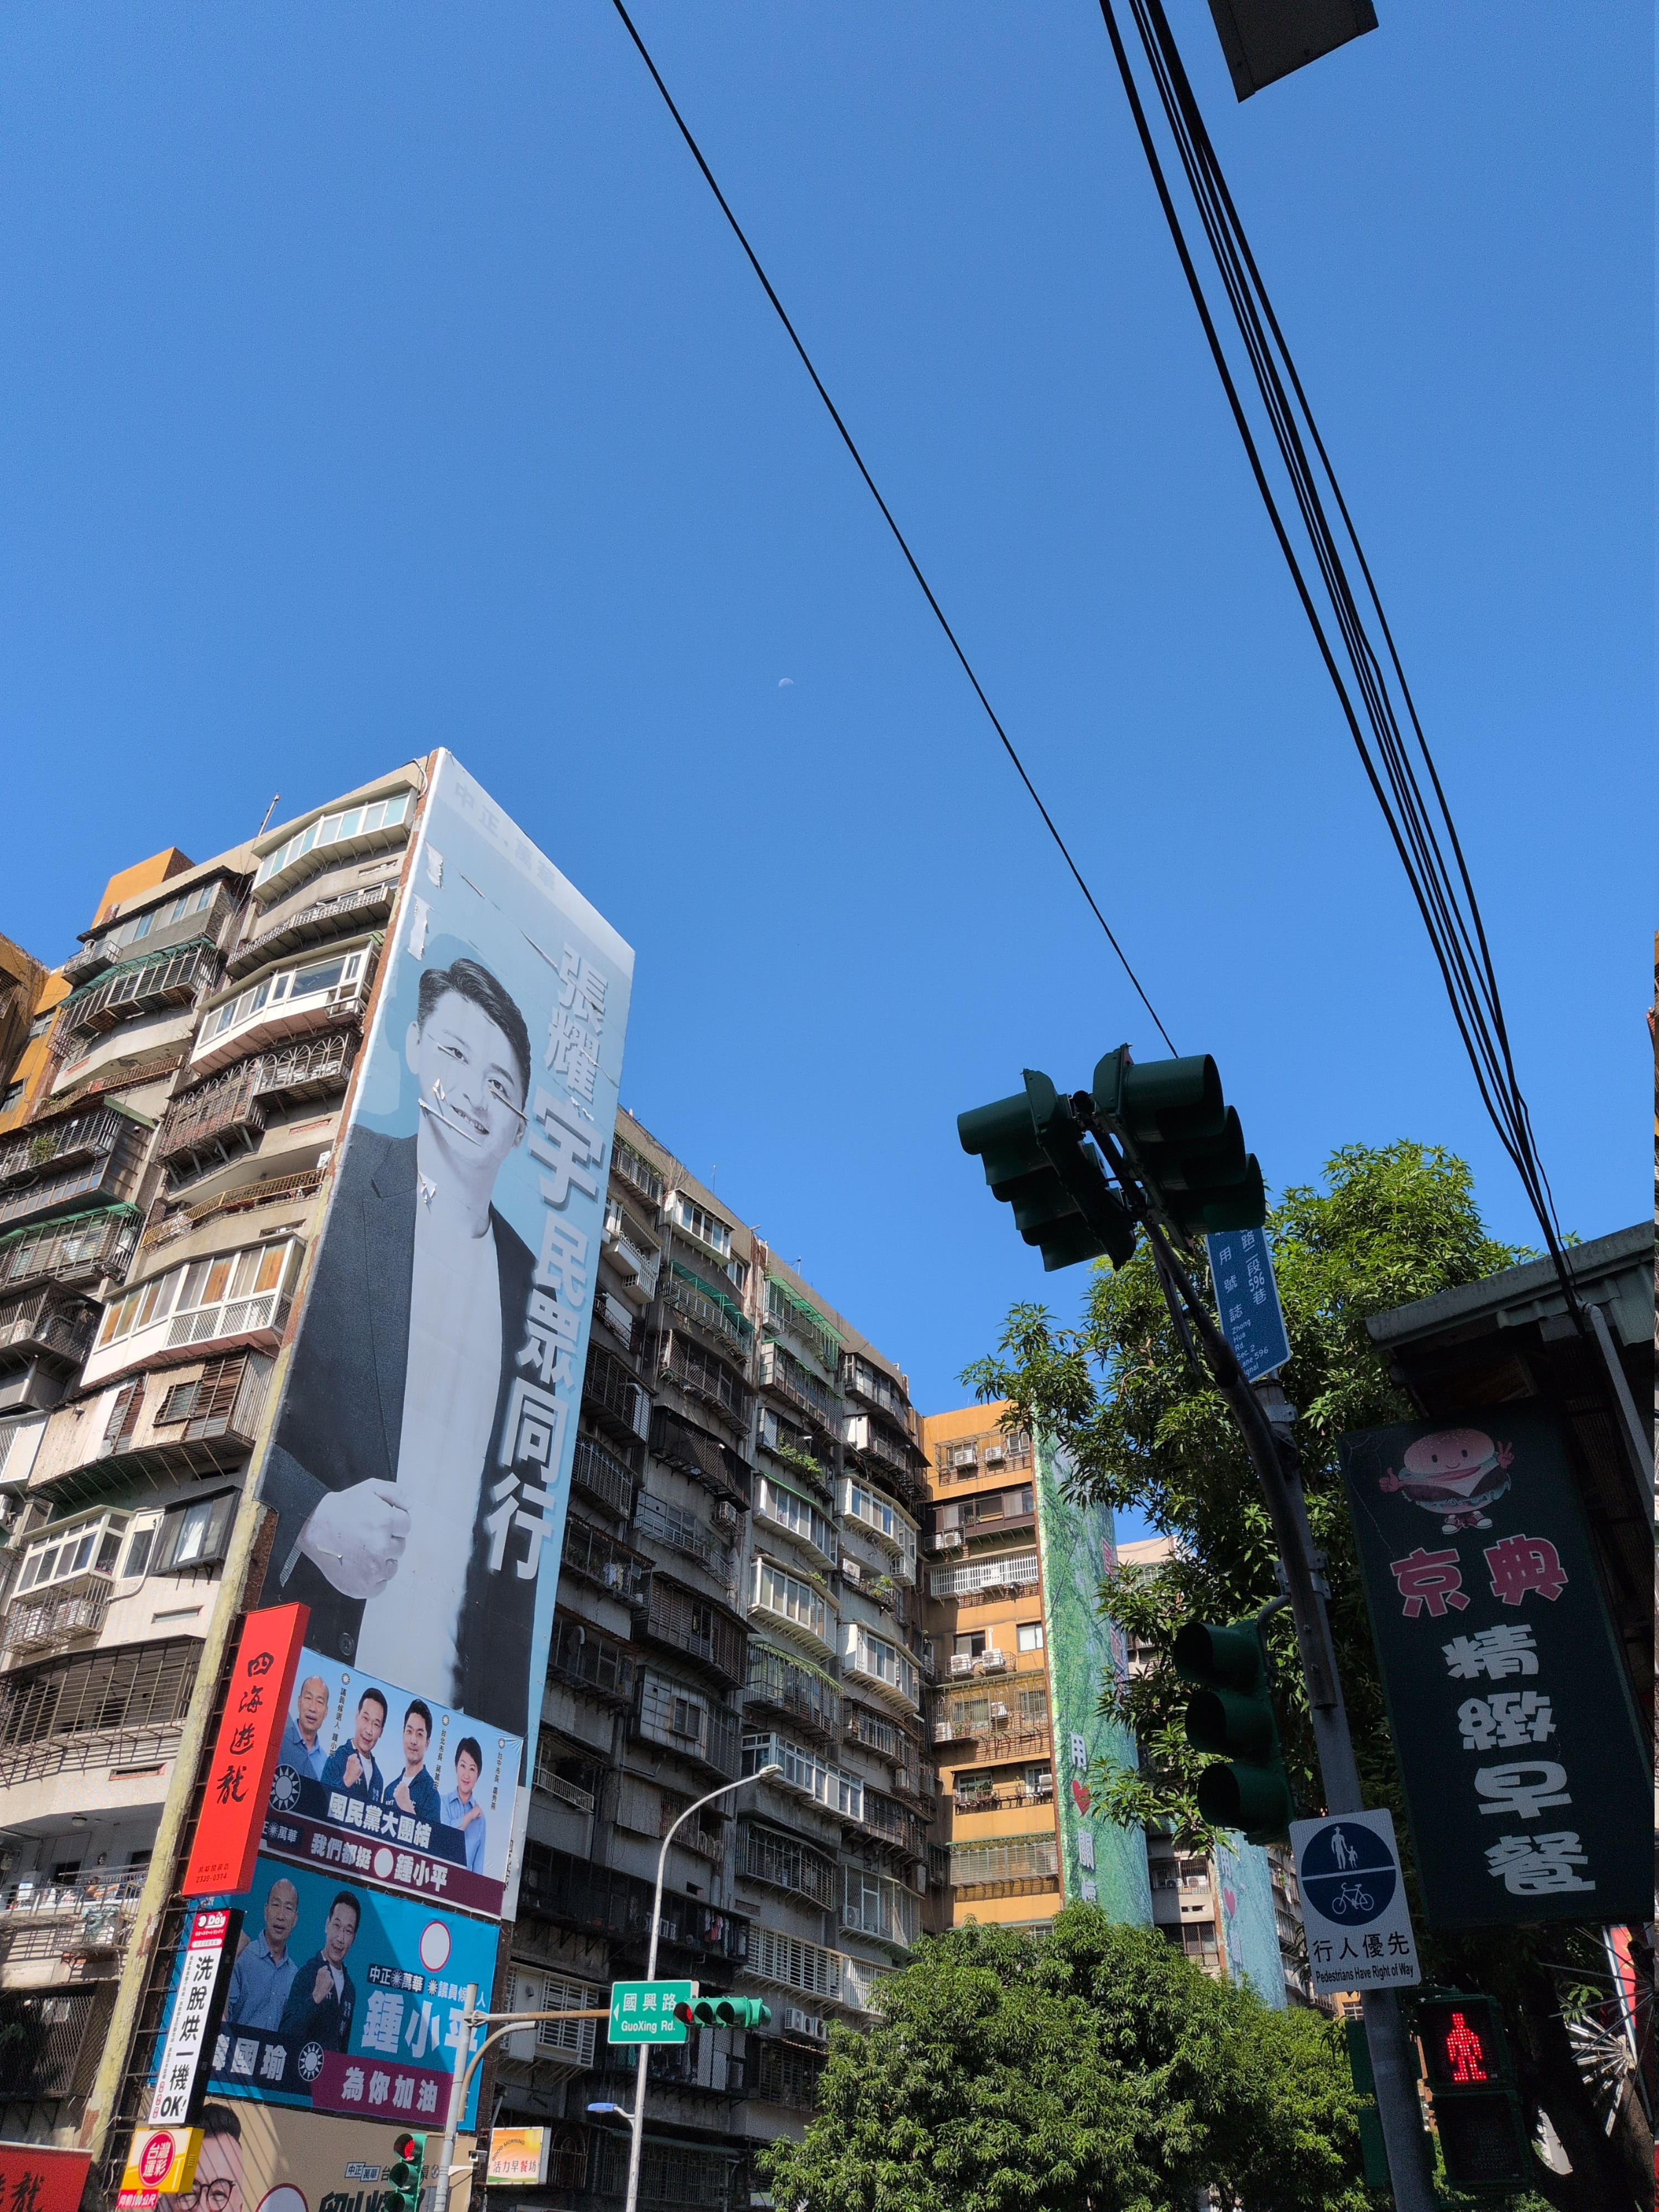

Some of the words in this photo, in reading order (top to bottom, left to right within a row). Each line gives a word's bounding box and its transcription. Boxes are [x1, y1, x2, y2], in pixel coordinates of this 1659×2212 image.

[1215, 1232, 1243, 1323] 用號誌
[1239, 1230, 1267, 1305] 路二段596巷
[1232, 1319, 1251, 1335] Zhong
[1233, 1332, 1246, 1344] Hua
[1241, 1358, 1254, 1369] ane
[1254, 1346, 1269, 1360] 596
[1250, 1344, 1256, 1353] 2
[1390, 1533, 1568, 1618] 京典
[216, 1652, 275, 1804] 四海遊龍
[1070, 1731, 1087, 1772] 用
[1441, 1624, 1596, 1896] 精緻早餐
[327, 1792, 432, 1849] 國民黨大團結
[277, 1825, 298, 1843] 萬華
[311, 1833, 373, 1871] 我們都挺
[394, 1853, 449, 1893] 鍾小平
[195, 1873, 227, 1883] 2339-0374
[1312, 1931, 1410, 1963] 行人優先
[1316, 1967, 1354, 1983] Pedestrians
[1355, 1967, 1371, 1980] Have
[1373, 1964, 1391, 1982] Right
[1391, 1963, 1399, 1976] of
[1399, 1961, 1414, 1978] Way
[369, 1966, 392, 1985] 中正
[401, 1973, 424, 1992] 萬華
[438, 1981, 486, 2008] 議員候人
[623, 1993, 677, 2012] 國興路
[621, 2020, 657, 2034] GuoXing
[661, 2020, 675, 2031] Rd.
[341, 2067, 438, 2113] 為你加油
[492, 2146, 503, 2161] GOOD
[504, 2138, 525, 2147] MORNING
[348, 2164, 362, 2176] 中正
[362, 2167, 379, 2180] 萬華
[493, 2160, 538, 2173] 活力早餐坊
